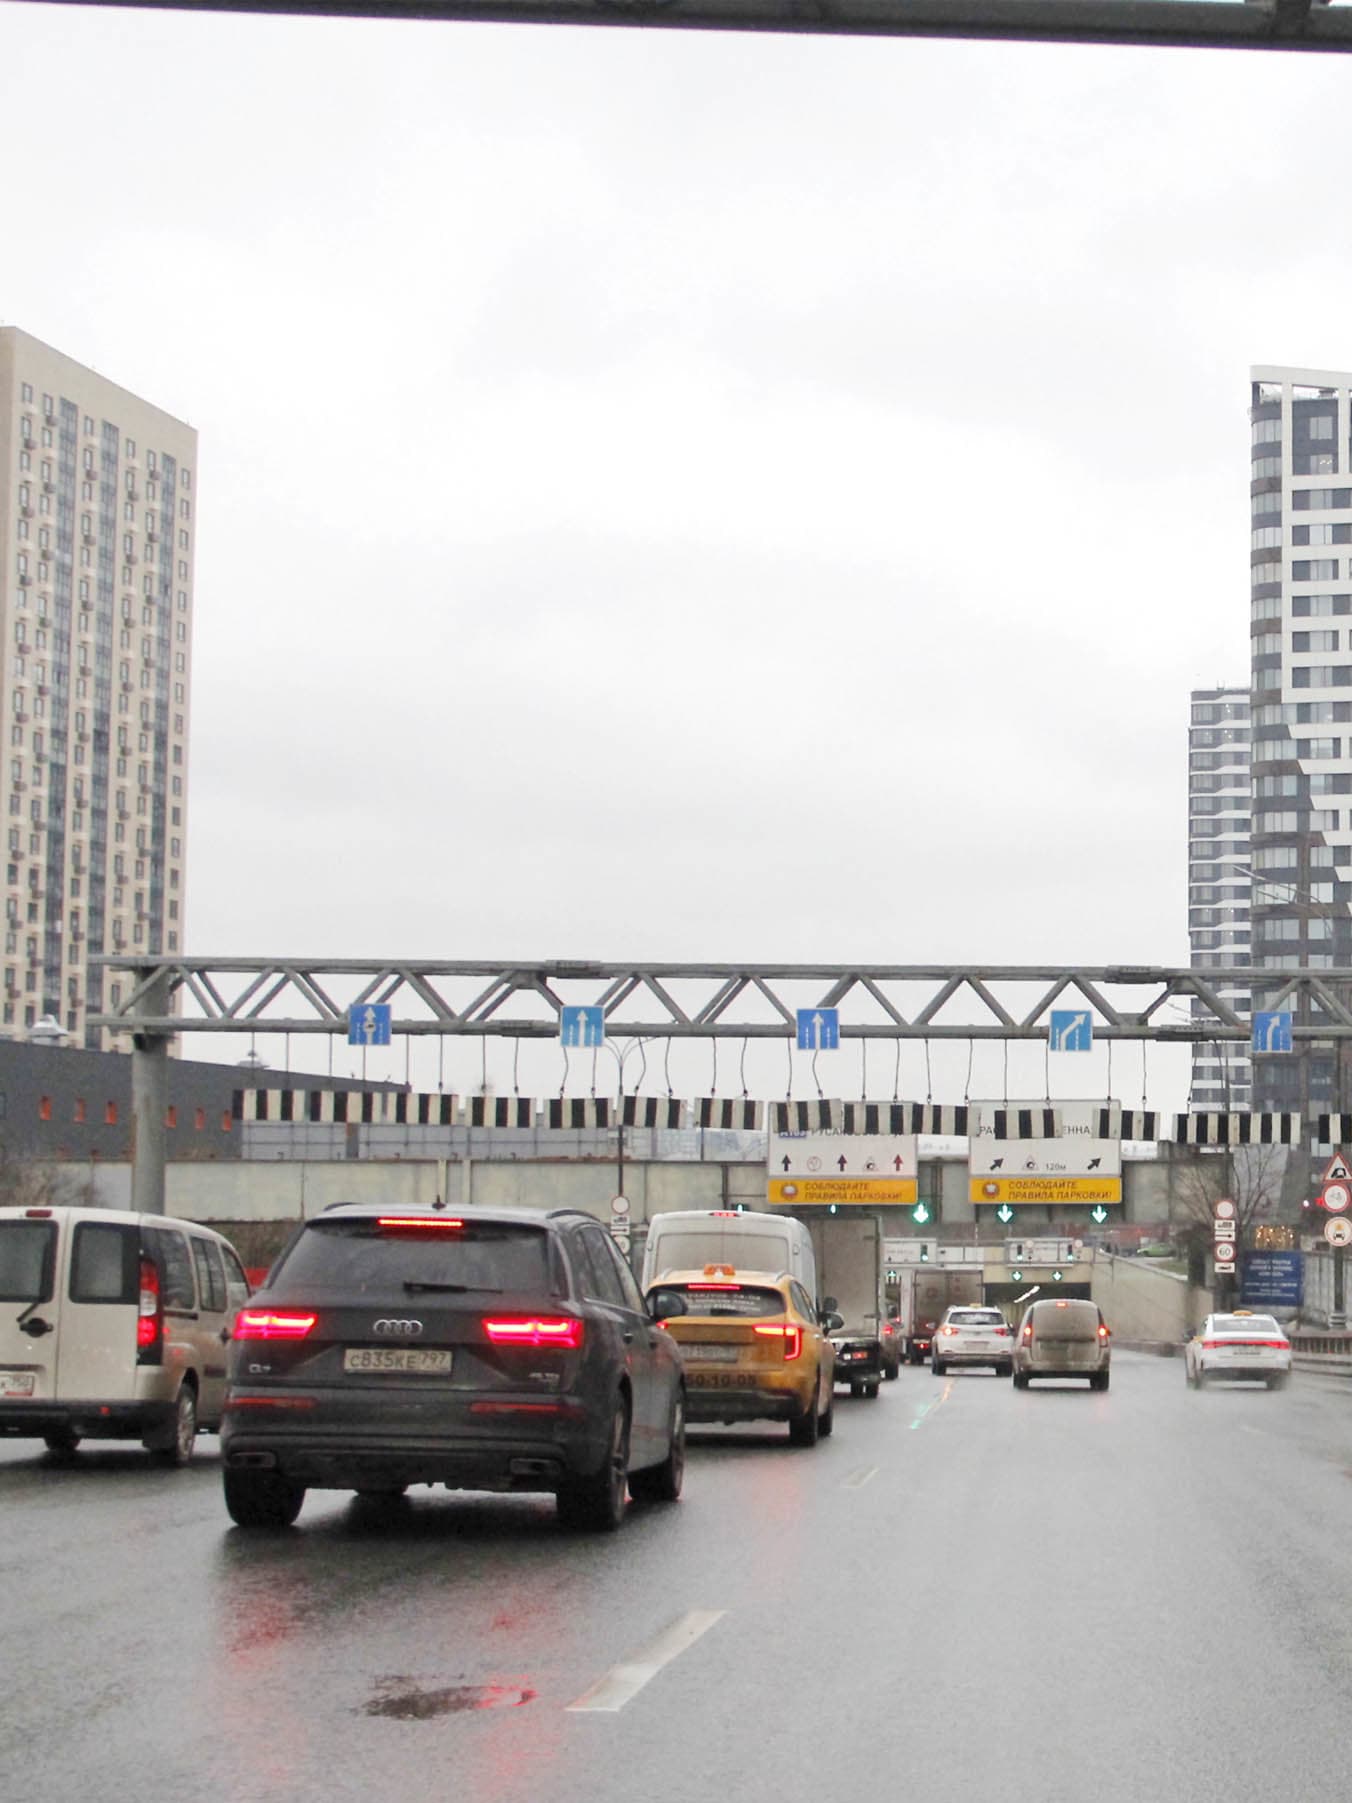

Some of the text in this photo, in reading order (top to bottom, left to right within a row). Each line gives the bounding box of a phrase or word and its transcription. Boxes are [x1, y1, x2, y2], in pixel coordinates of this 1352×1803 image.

[1008, 1180, 1078, 1190] СОБЛЮДАЙТЕ
[1008, 1191, 1054, 1200] ПРАВИЛА
[1219, 1247, 1231, 1257] 60
[350, 1351, 417, 1369] С835КЕ
